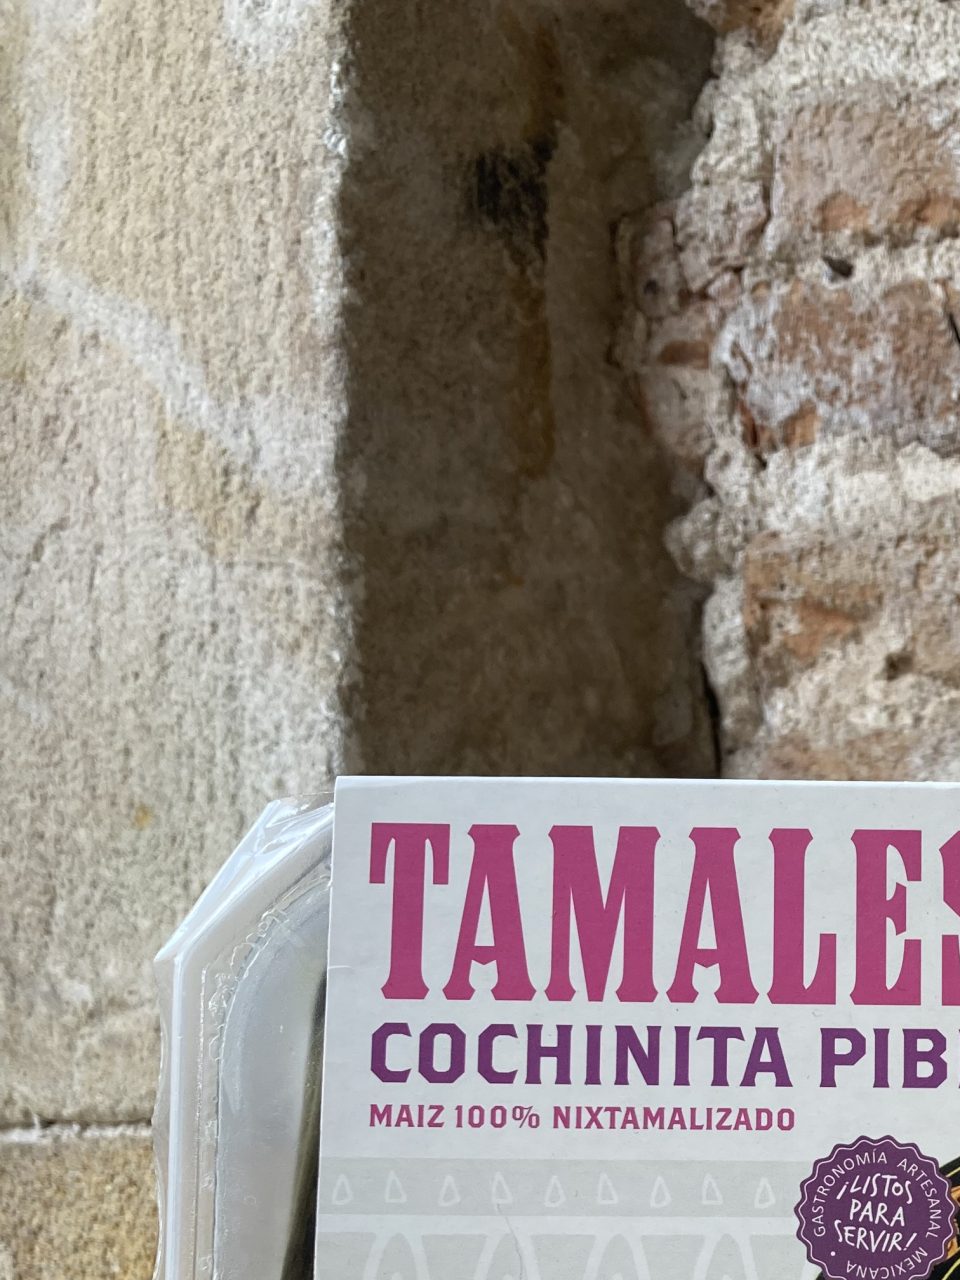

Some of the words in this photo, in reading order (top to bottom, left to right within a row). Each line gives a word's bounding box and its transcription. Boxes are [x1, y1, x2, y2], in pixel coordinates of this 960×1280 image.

[371, 1022, 794, 1088] COCHINITA
[369, 1103, 445, 1129] MAIZ
[454, 1105, 541, 1130] 100%
[553, 1106, 796, 1132] NIXTAMALIZADO
[812, 1148, 888, 1237] GASTRONOMÍA
[896, 1158, 942, 1238] ARTESANAL
[849, 1198, 905, 1228] PARA
[834, 1219, 918, 1253] SERVIR!
[846, 1246, 929, 1280] MEXICANA
